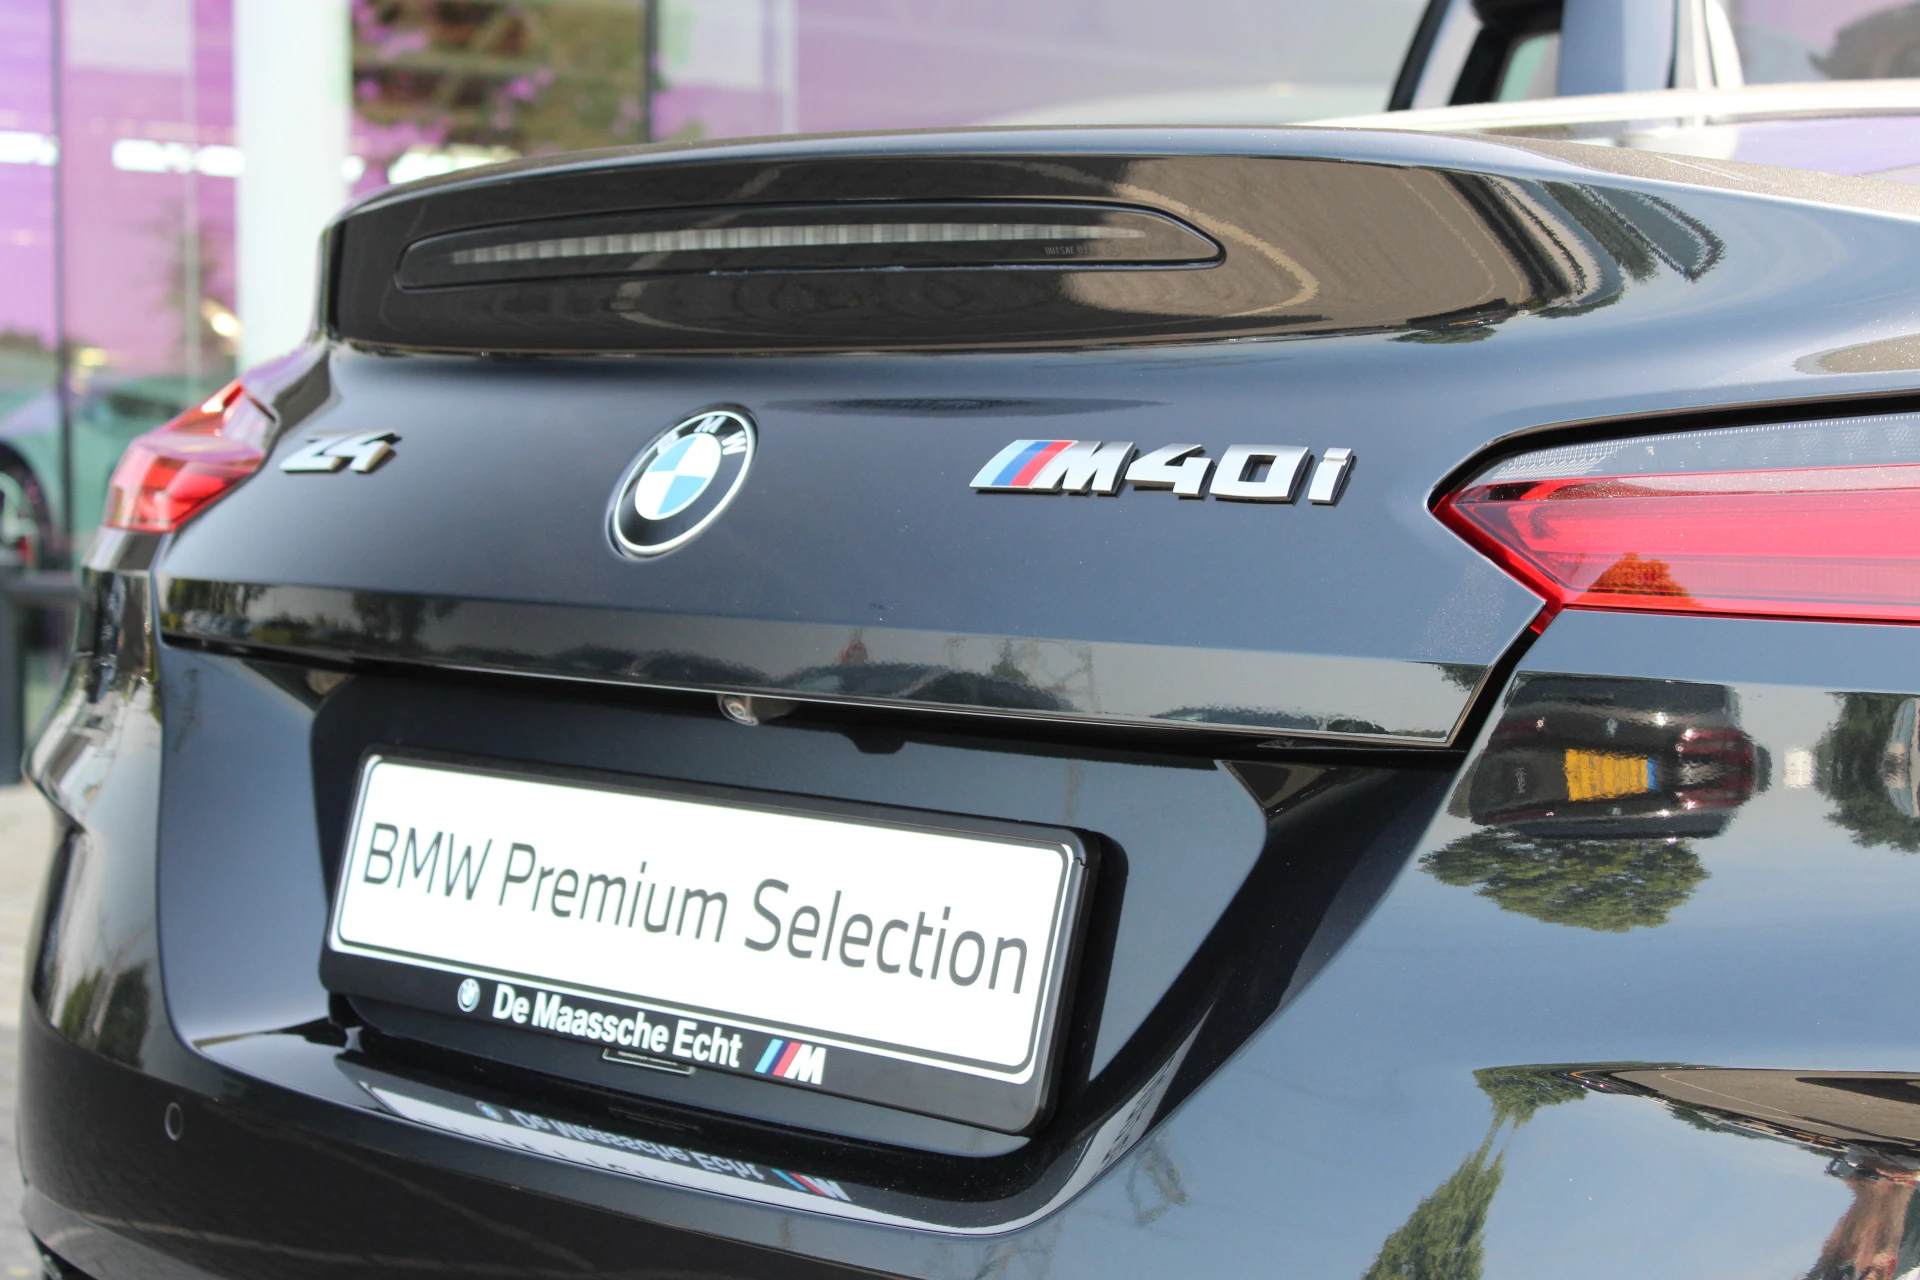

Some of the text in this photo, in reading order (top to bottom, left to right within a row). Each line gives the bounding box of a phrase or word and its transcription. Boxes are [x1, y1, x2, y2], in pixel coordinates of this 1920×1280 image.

[280, 430, 401, 473] Z4
[657, 415, 747, 456] BMW
[1031, 439, 1352, 504] M40i
[362, 822, 1029, 995] BMW Premium Selection
[492, 983, 827, 1085] De Maassche Echt M
